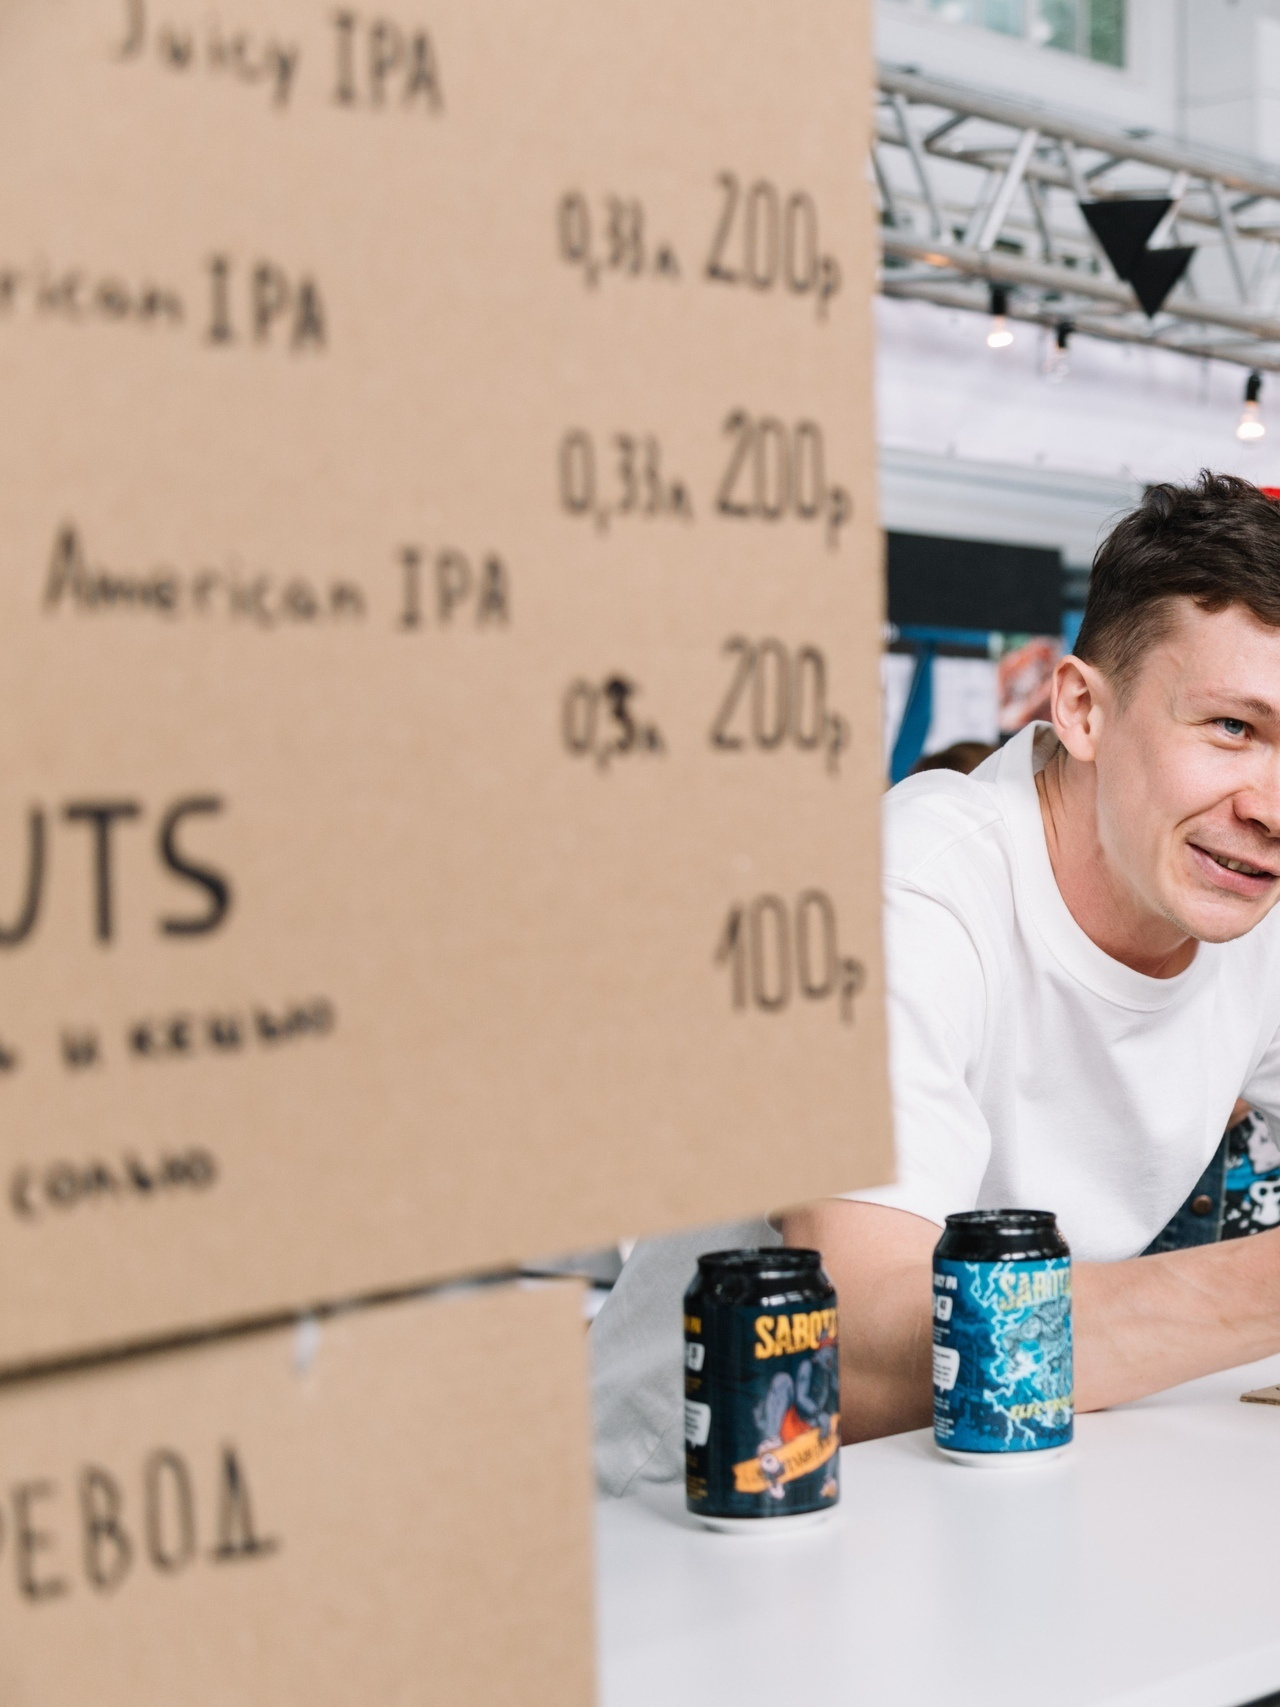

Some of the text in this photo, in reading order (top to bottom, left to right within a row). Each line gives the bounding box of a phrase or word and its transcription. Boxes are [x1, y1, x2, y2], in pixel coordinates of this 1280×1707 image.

[119, 0, 443, 113] Juicy IPA
[206, 253, 328, 351] IPA
[43, 521, 510, 632] American IPA
[0, 1443, 278, 1605] ЕВОД
